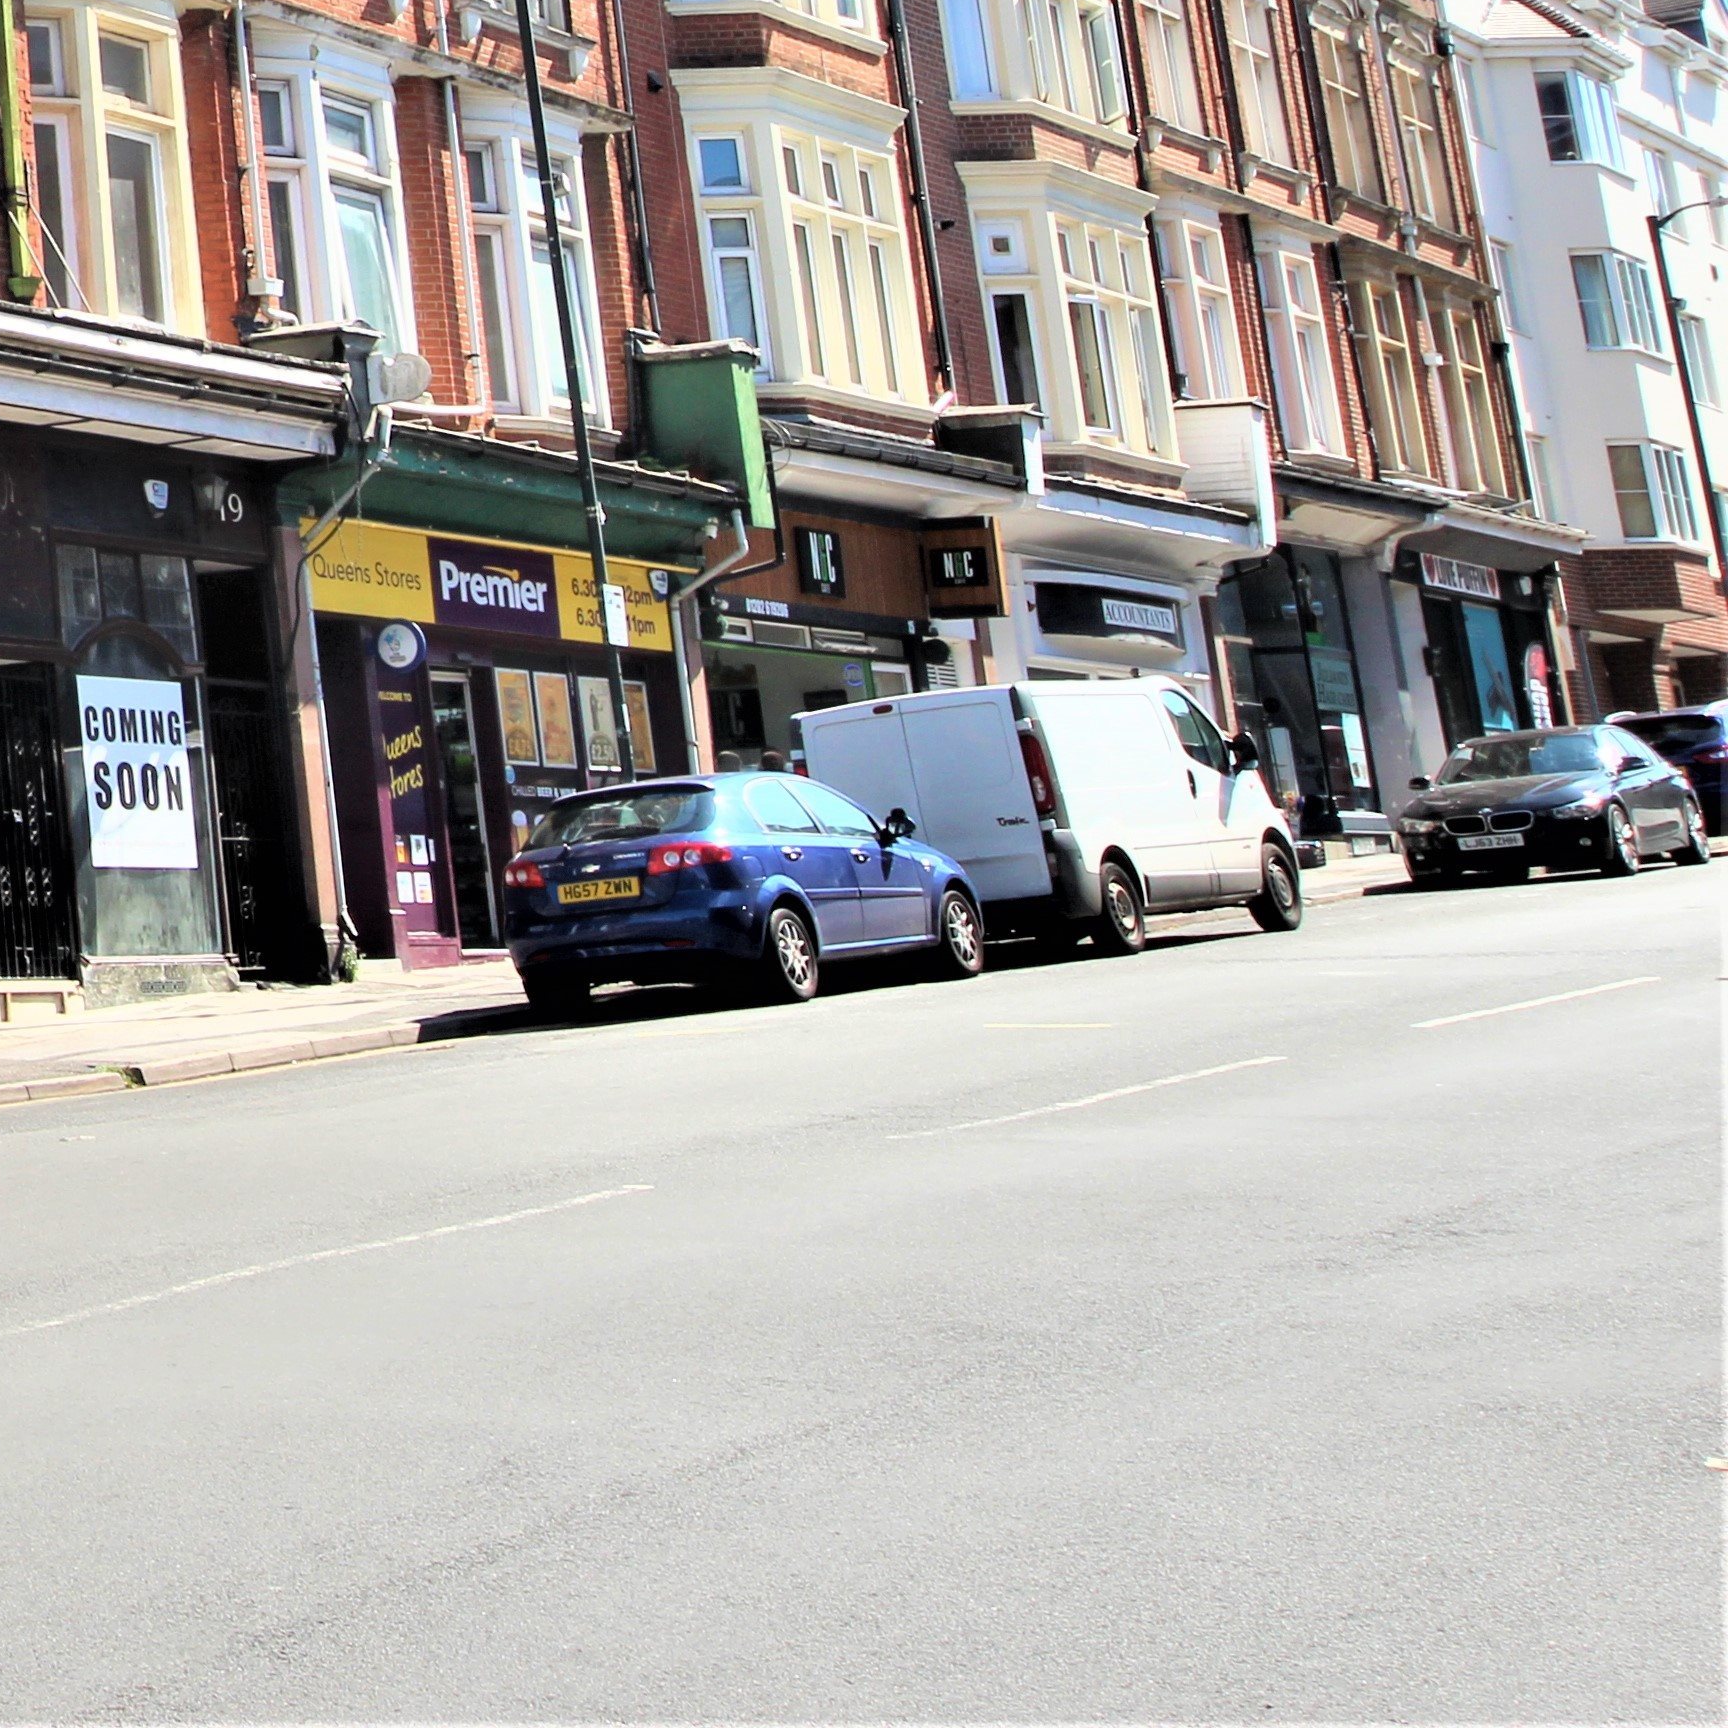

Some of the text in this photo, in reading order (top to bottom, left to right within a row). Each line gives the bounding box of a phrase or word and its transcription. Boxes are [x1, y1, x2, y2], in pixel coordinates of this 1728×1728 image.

[312, 553, 422, 591] Queens Stores
[439, 559, 547, 612] Premier
[1105, 603, 1171, 630] ACCOUNTANTS
[84, 705, 182, 746] COMING
[382, 725, 422, 760] ueens
[94, 761, 183, 810] SOON
[388, 763, 423, 799] tores
[564, 878, 633, 900] HG57 ZWN
